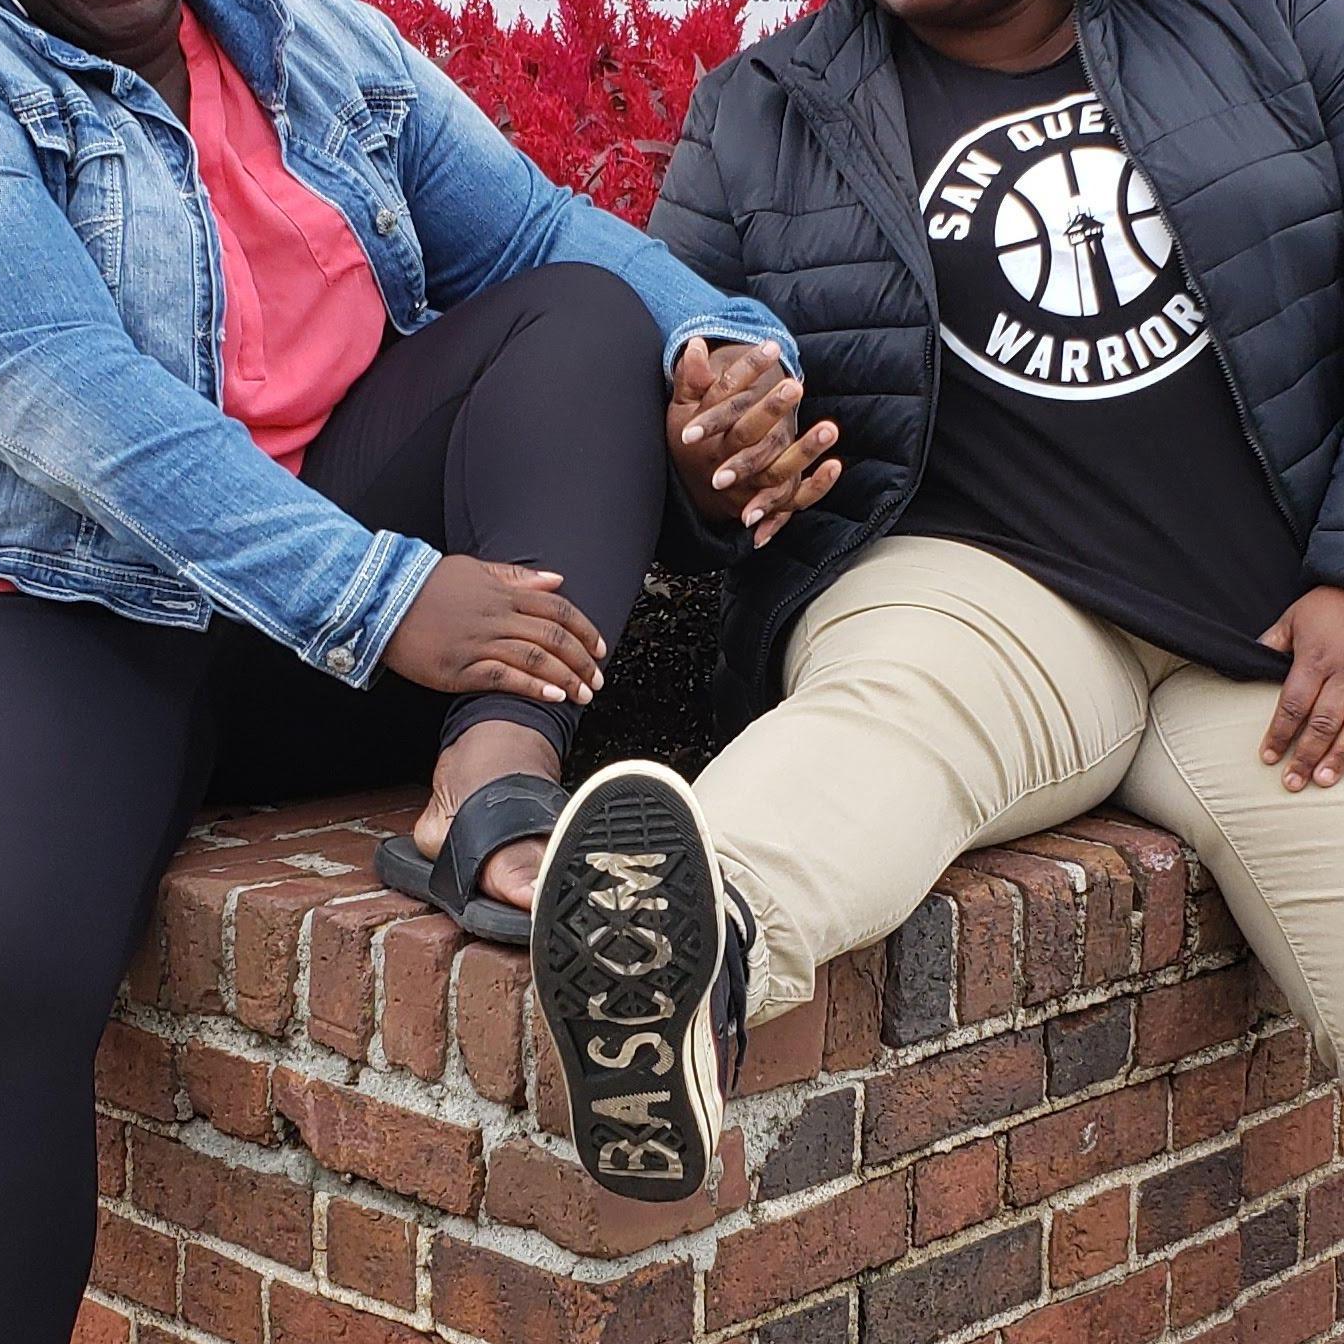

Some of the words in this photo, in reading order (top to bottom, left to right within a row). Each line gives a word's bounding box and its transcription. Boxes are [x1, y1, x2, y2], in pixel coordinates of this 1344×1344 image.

[928, 149, 1002, 242] SAN
[1006, 104, 1119, 153] QUE
[985, 292, 1207, 384] WARRIOR
[584, 852, 684, 1181] BASCOM
